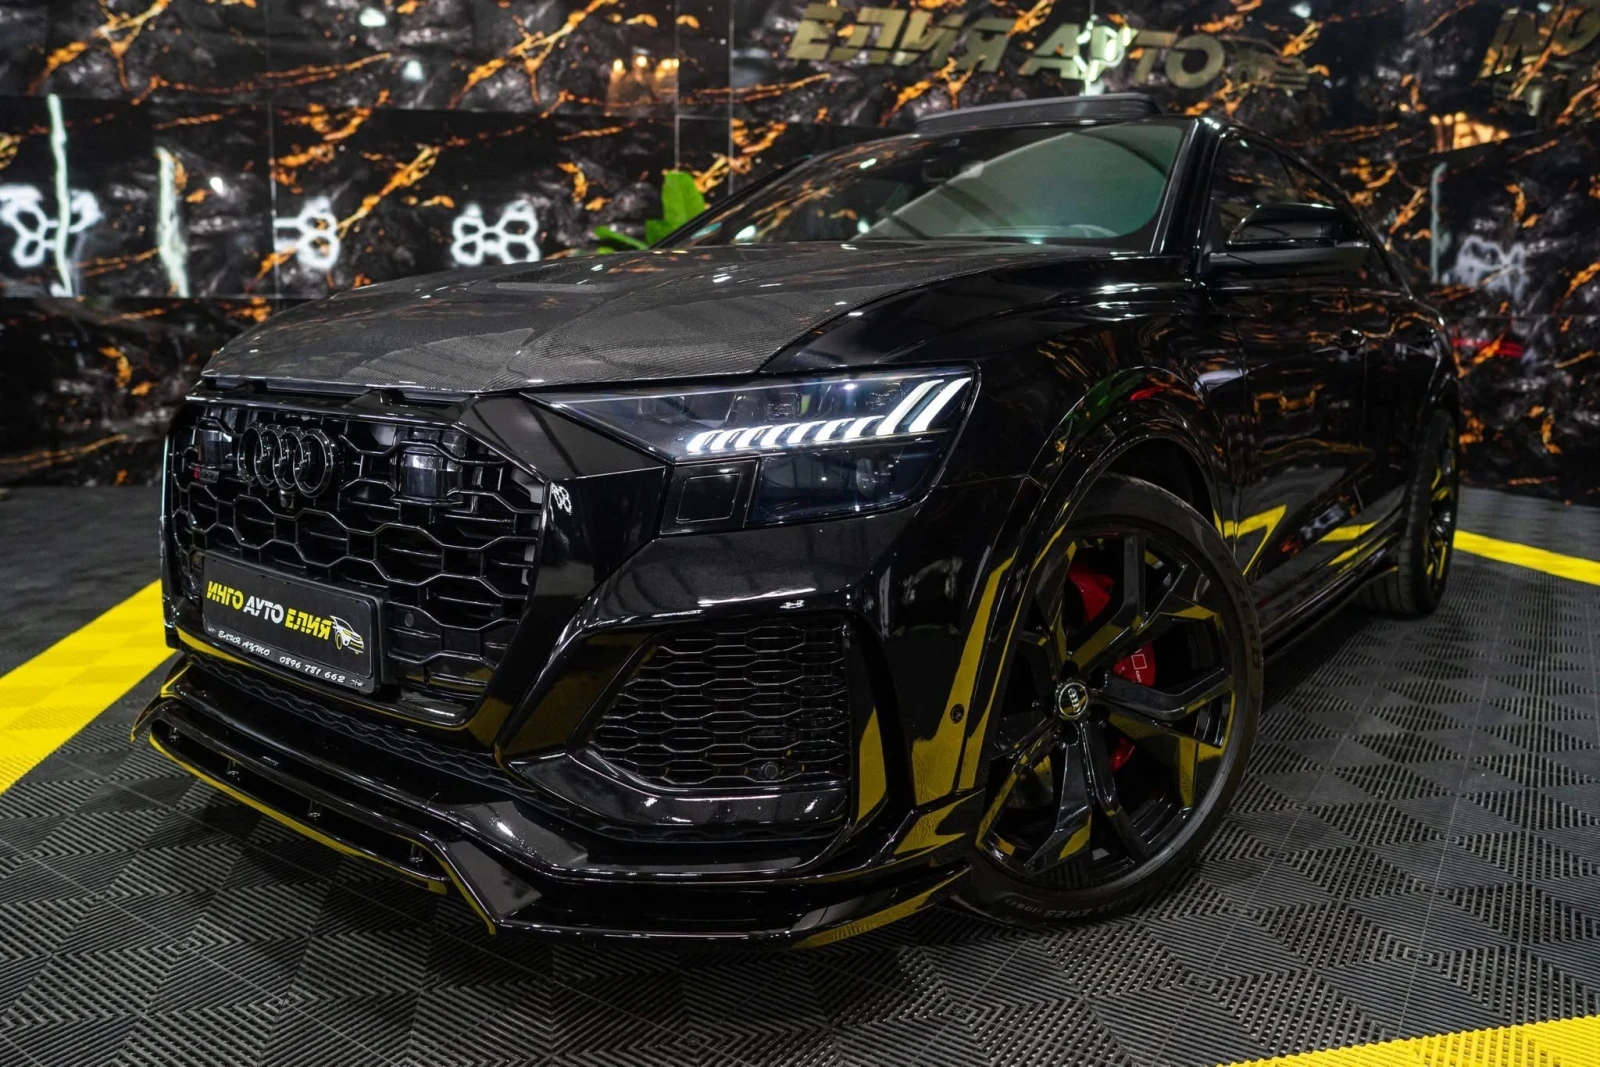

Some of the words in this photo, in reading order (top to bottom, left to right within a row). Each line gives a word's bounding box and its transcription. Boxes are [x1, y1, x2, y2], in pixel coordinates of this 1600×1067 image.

[786, 3, 1015, 73] ЕЛИЯ
[206, 581, 244, 610] ИНГО
[243, 595, 284, 624] АУТО
[285, 608, 333, 640] ЕЛИЯ
[279, 656, 302, 669] 0896
[304, 664, 321, 676] 781
[324, 671, 346, 683] 662
